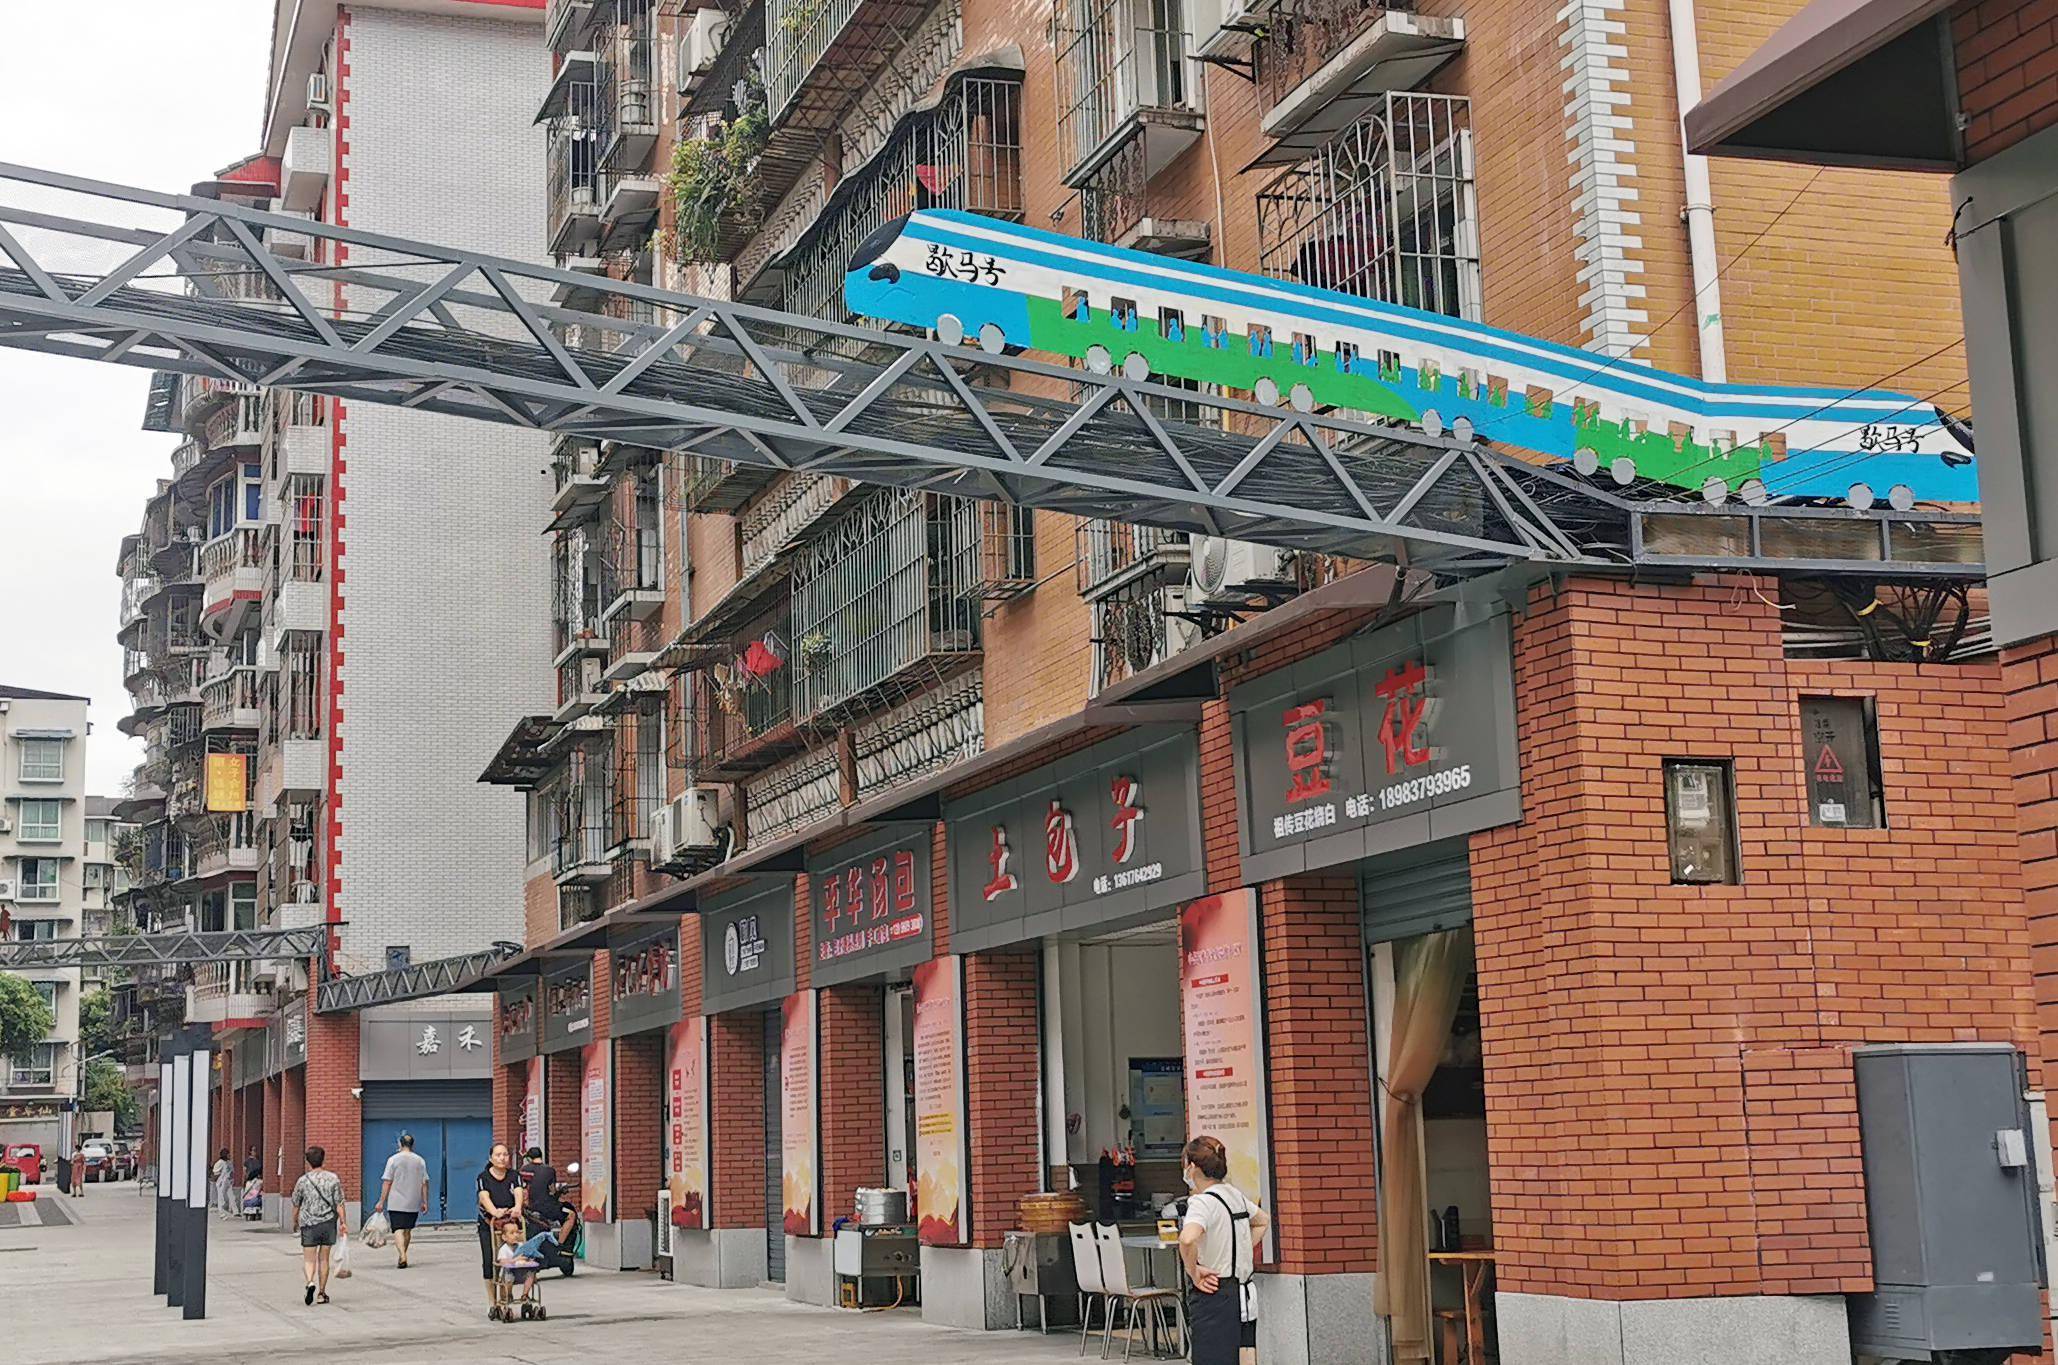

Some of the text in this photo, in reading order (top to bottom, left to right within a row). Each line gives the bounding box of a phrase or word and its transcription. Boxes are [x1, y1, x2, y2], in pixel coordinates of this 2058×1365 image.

[926, 243, 1007, 287] 歇马号
[1282, 660, 1434, 803] 豆花
[1273, 803, 1336, 838] 祖传豆花烧白
[416, 1024, 483, 1055] 嘉禾
